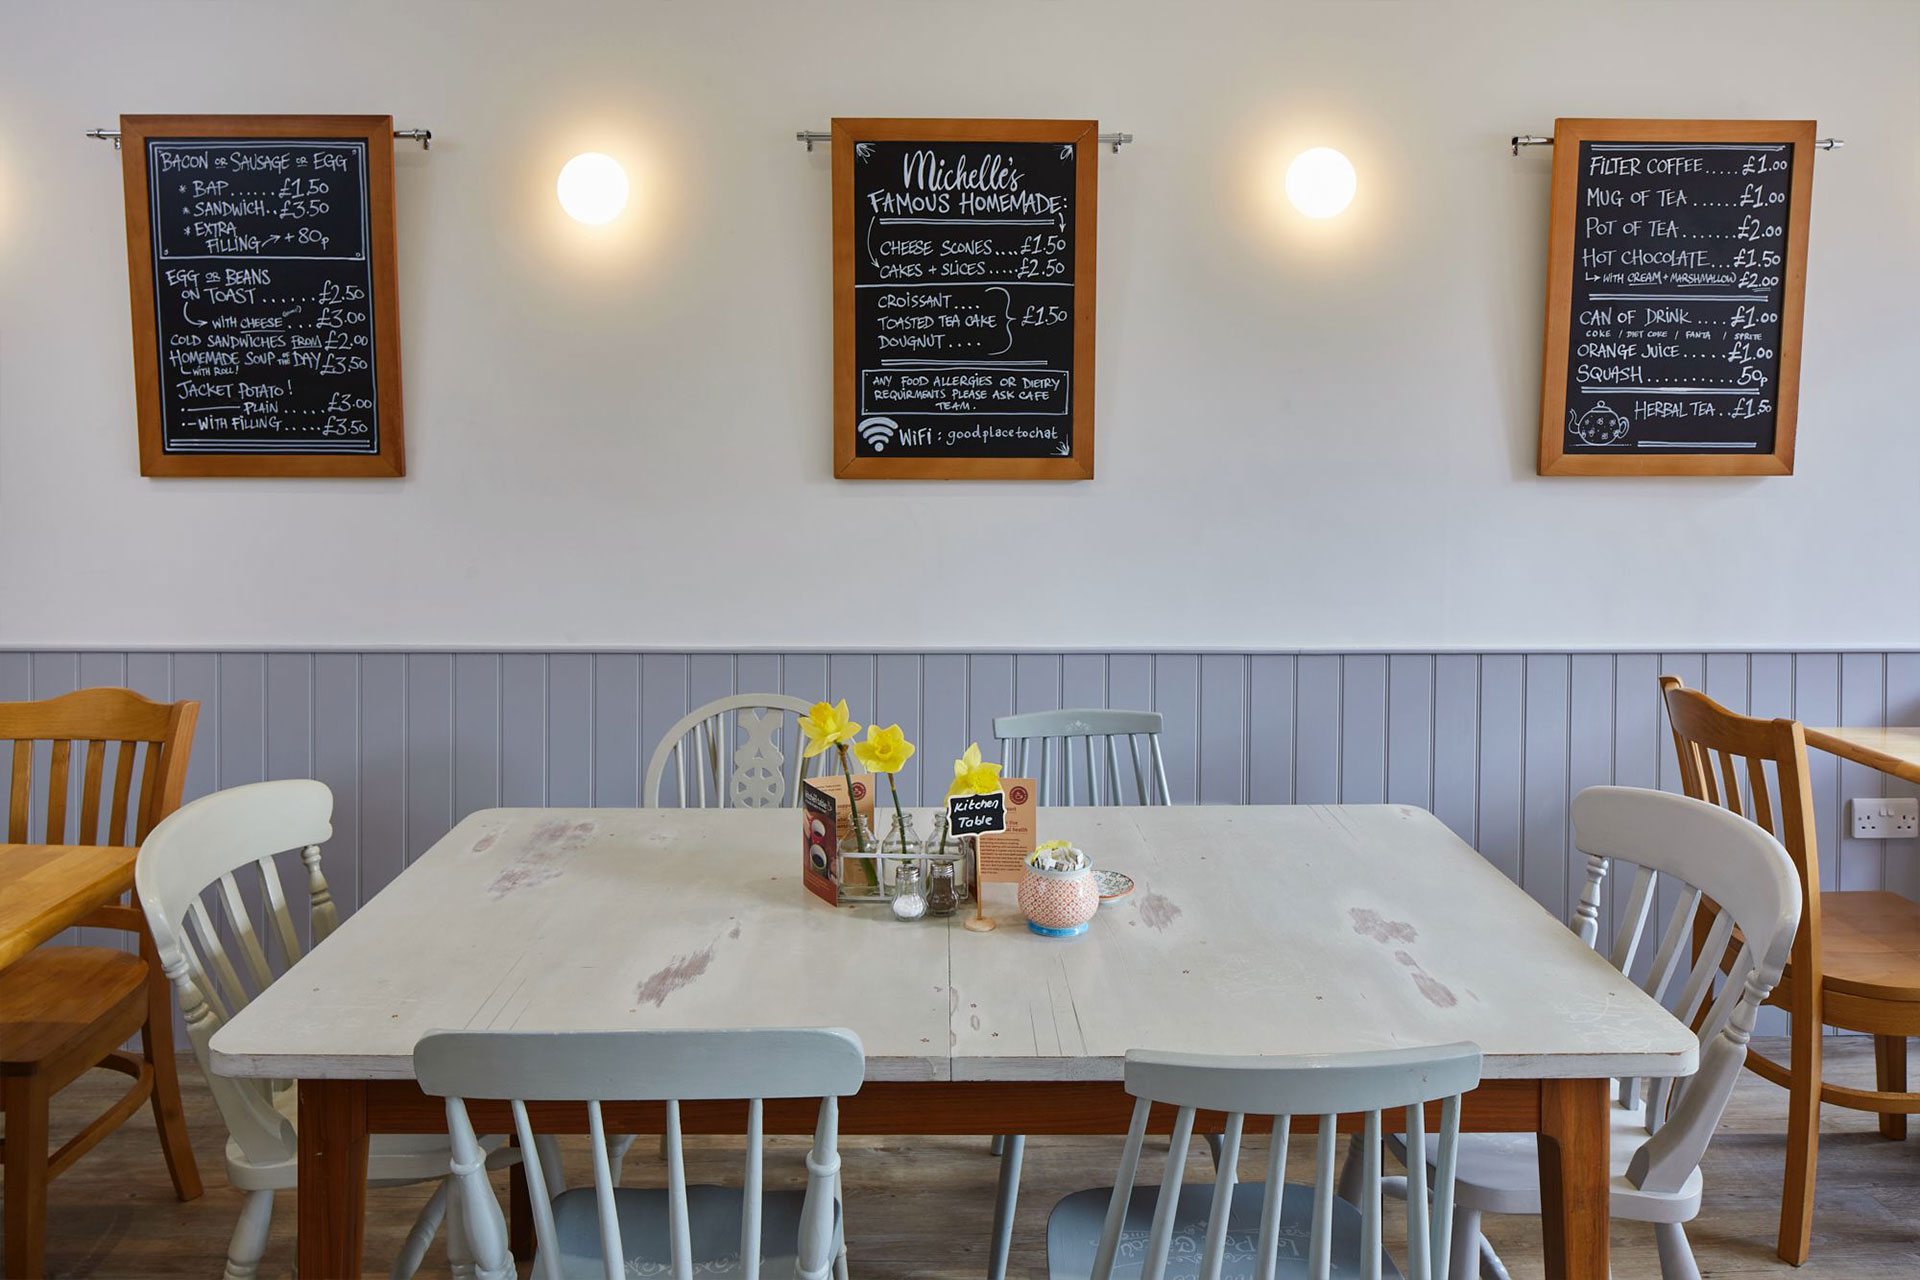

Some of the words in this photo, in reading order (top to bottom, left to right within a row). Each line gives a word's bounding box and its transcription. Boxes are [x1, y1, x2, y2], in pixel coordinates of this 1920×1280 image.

[160, 151, 208, 171] BACON
[230, 152, 289, 174] SAUSAGE
[296, 157, 308, 166] OR
[314, 152, 347, 171] EGG
[904, 150, 1025, 192] Michelle's
[1590, 156, 1641, 176] FILTER
[1647, 157, 1703, 175] COFFEE
[1742, 154, 1787, 176] £1.00
[193, 180, 229, 197] BAP
[279, 178, 329, 198] £1.50
[1588, 188, 1624, 207] MUG
[1631, 190, 1651, 206] OF
[1657, 189, 1687, 207] TEA
[1740, 184, 1785, 208] £1.00
[194, 199, 264, 216] SANDWICH
[280, 200, 329, 219] £3.50
[867, 188, 950, 215] FAMOUS
[194, 221, 237, 238] EXTRA
[1587, 217, 1617, 238] POT
[1623, 221, 1642, 236] OF
[1648, 220, 1679, 238] TEA
[1738, 215, 1782, 241] £2.00
[206, 234, 261, 253] FILLING
[299, 228, 329, 250] 80p
[880, 240, 933, 255] CHEESE
[940, 240, 992, 256] SCONES
[1021, 234, 1066, 254] £1.50
[880, 264, 922, 278] CAKES
[941, 260, 985, 275] SLICES
[1017, 257, 1064, 279] £2.50
[1582, 248, 1616, 267] HOT
[1621, 249, 1710, 268] CHOCOLATE
[1734, 248, 1780, 268] £1.50
[166, 269, 199, 287] EGG
[206, 272, 220, 281] OR
[225, 269, 270, 286] BEANS
[1603, 273, 1624, 284] WITH
[1627, 271, 1662, 285] CREAM
[1670, 272, 1736, 285] MARSHMALLOW
[1738, 271, 1779, 289] £2.00
[182, 285, 200, 300] ON
[204, 287, 255, 304] TOAST
[319, 280, 364, 304] £2.50
[878, 292, 952, 308] CROISSANT
[212, 316, 237, 329] WITH
[241, 318, 282, 329] CHEESE
[316, 307, 365, 328] £3.00
[878, 316, 934, 330] TOASTED
[938, 314, 960, 327] TEA
[965, 314, 997, 327] CAKE
[1022, 306, 1067, 326] £1.50
[1580, 307, 1612, 326] CAN
[1617, 310, 1636, 324] OF
[1644, 307, 1692, 326] DRINK
[1731, 306, 1777, 329] £1.00
[171, 334, 201, 346] COLD
[208, 334, 286, 349] SANDWICHES
[291, 335, 322, 347] FROM
[325, 330, 368, 351] £2.00
[878, 334, 945, 350] DOUGNUT
[1627, 330, 1644, 338] DIET
[1686, 331, 1711, 340] FANTA
[169, 350, 239, 368] HOMEMADE
[245, 352, 275, 365] SOUP
[292, 351, 321, 369] DAY
[320, 353, 367, 375] £3.50
[1577, 343, 1637, 360] ORANGE
[1641, 343, 1679, 358] JUICE
[1728, 341, 1773, 364] £1.00
[193, 367, 210, 376] WITH
[873, 376, 892, 386] ANY
[901, 376, 929, 387] FOOD
[934, 373, 992, 387] ALLERGIES
[1000, 377, 1016, 387] OR
[1023, 378, 1060, 392] DIETRY
[1576, 364, 1643, 383] SQUASH
[1737, 366, 1768, 387] 50p
[177, 380, 233, 399] JACKET
[874, 388, 946, 400] REQUIRMENTS
[952, 389, 987, 399] PLEASE
[992, 390, 1014, 399] ASK
[1019, 391, 1049, 401] CAFE
[244, 401, 278, 415] PLAIN
[328, 392, 372, 411] £3.00
[1634, 401, 1688, 420] HERBAL
[1689, 401, 1715, 416] TEA
[1731, 398, 1772, 419] £1.50
[198, 415, 227, 430] WITH
[232, 414, 282, 431] FILLING
[323, 416, 367, 435] £3.50
[958, 815, 992, 828] Table
